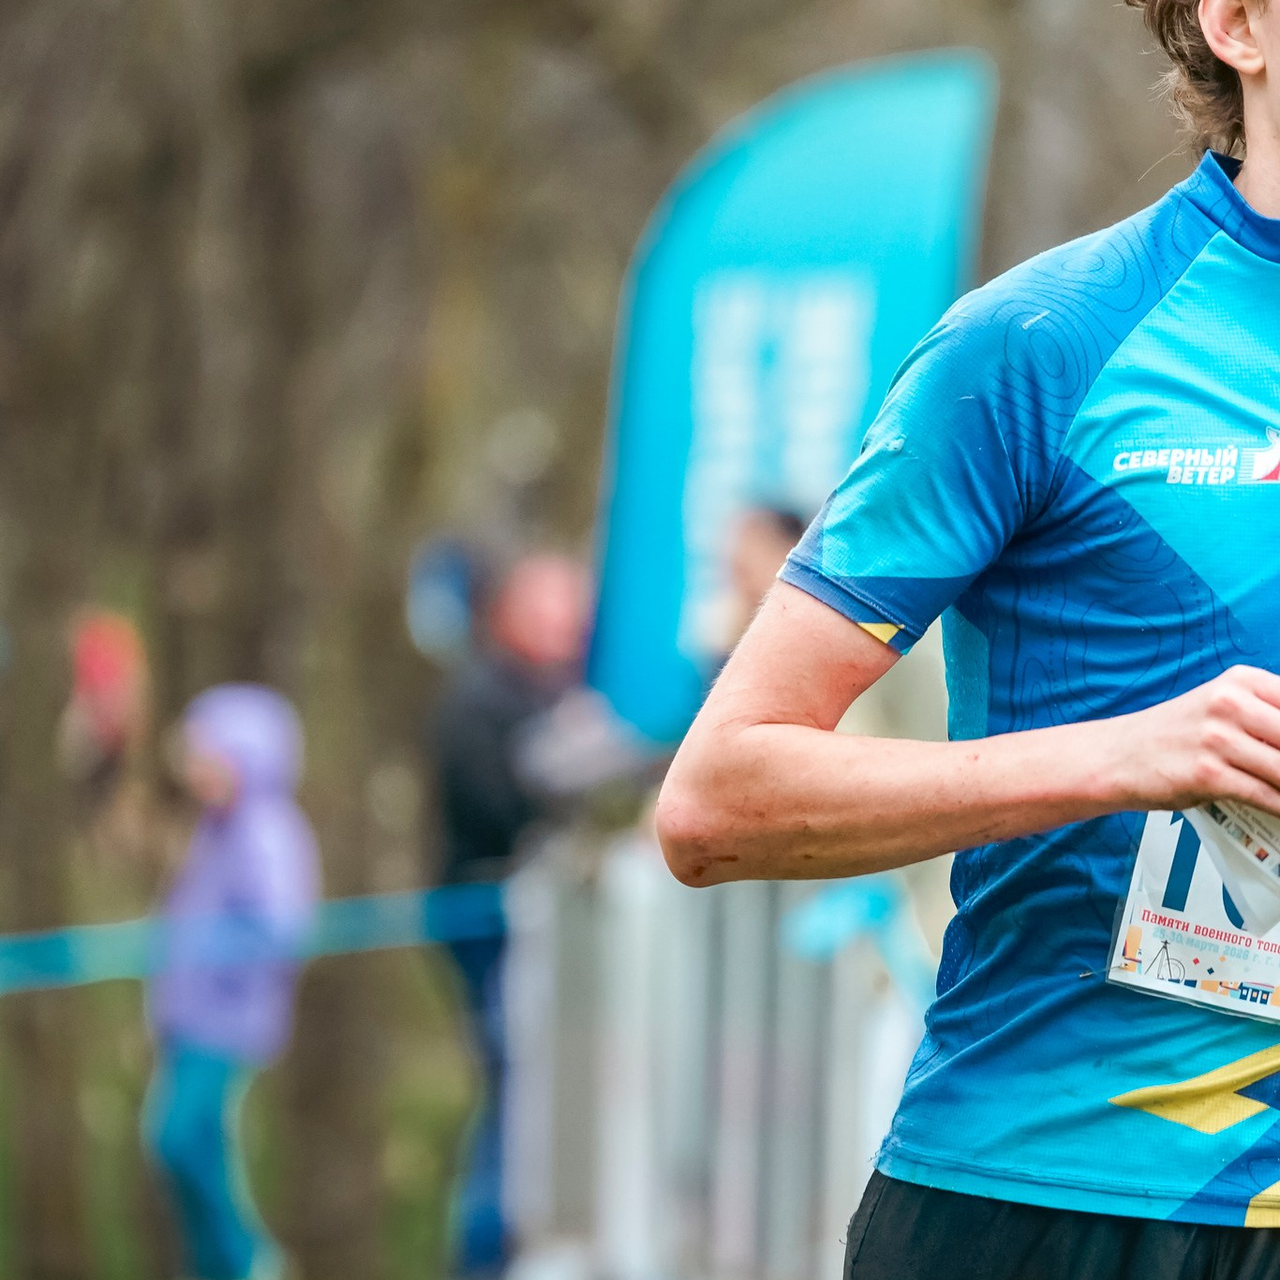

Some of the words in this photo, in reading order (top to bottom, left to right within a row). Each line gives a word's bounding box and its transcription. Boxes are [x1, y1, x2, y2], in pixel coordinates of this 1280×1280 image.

[1113, 445, 1239, 471] СЕВЕРНЫЙ
[1166, 466, 1236, 484] ВЕТЕР
[1141, 909, 1190, 932] Памяти
[1194, 924, 1252, 948] военного
